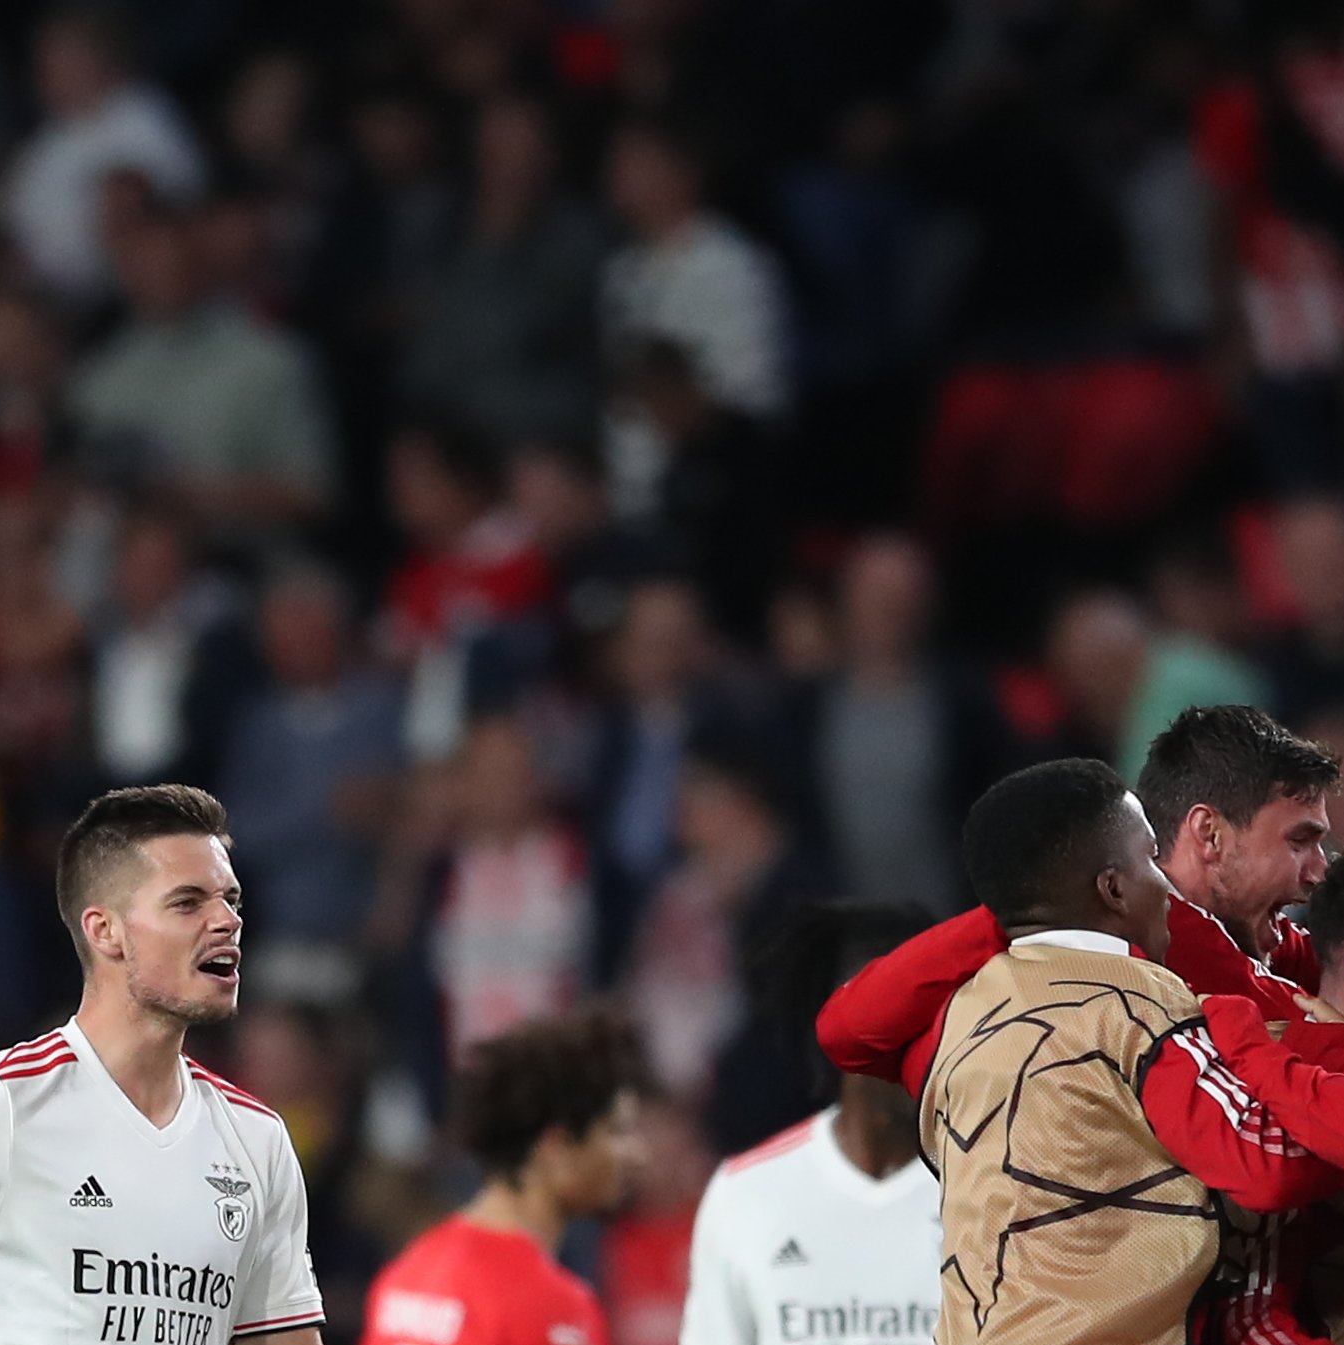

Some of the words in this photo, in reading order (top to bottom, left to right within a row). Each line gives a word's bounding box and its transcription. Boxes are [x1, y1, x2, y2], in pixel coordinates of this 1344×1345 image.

[70, 1195, 113, 1208] adidas
[72, 1248, 235, 1310] Emirates
[101, 1305, 146, 1342] FLY
